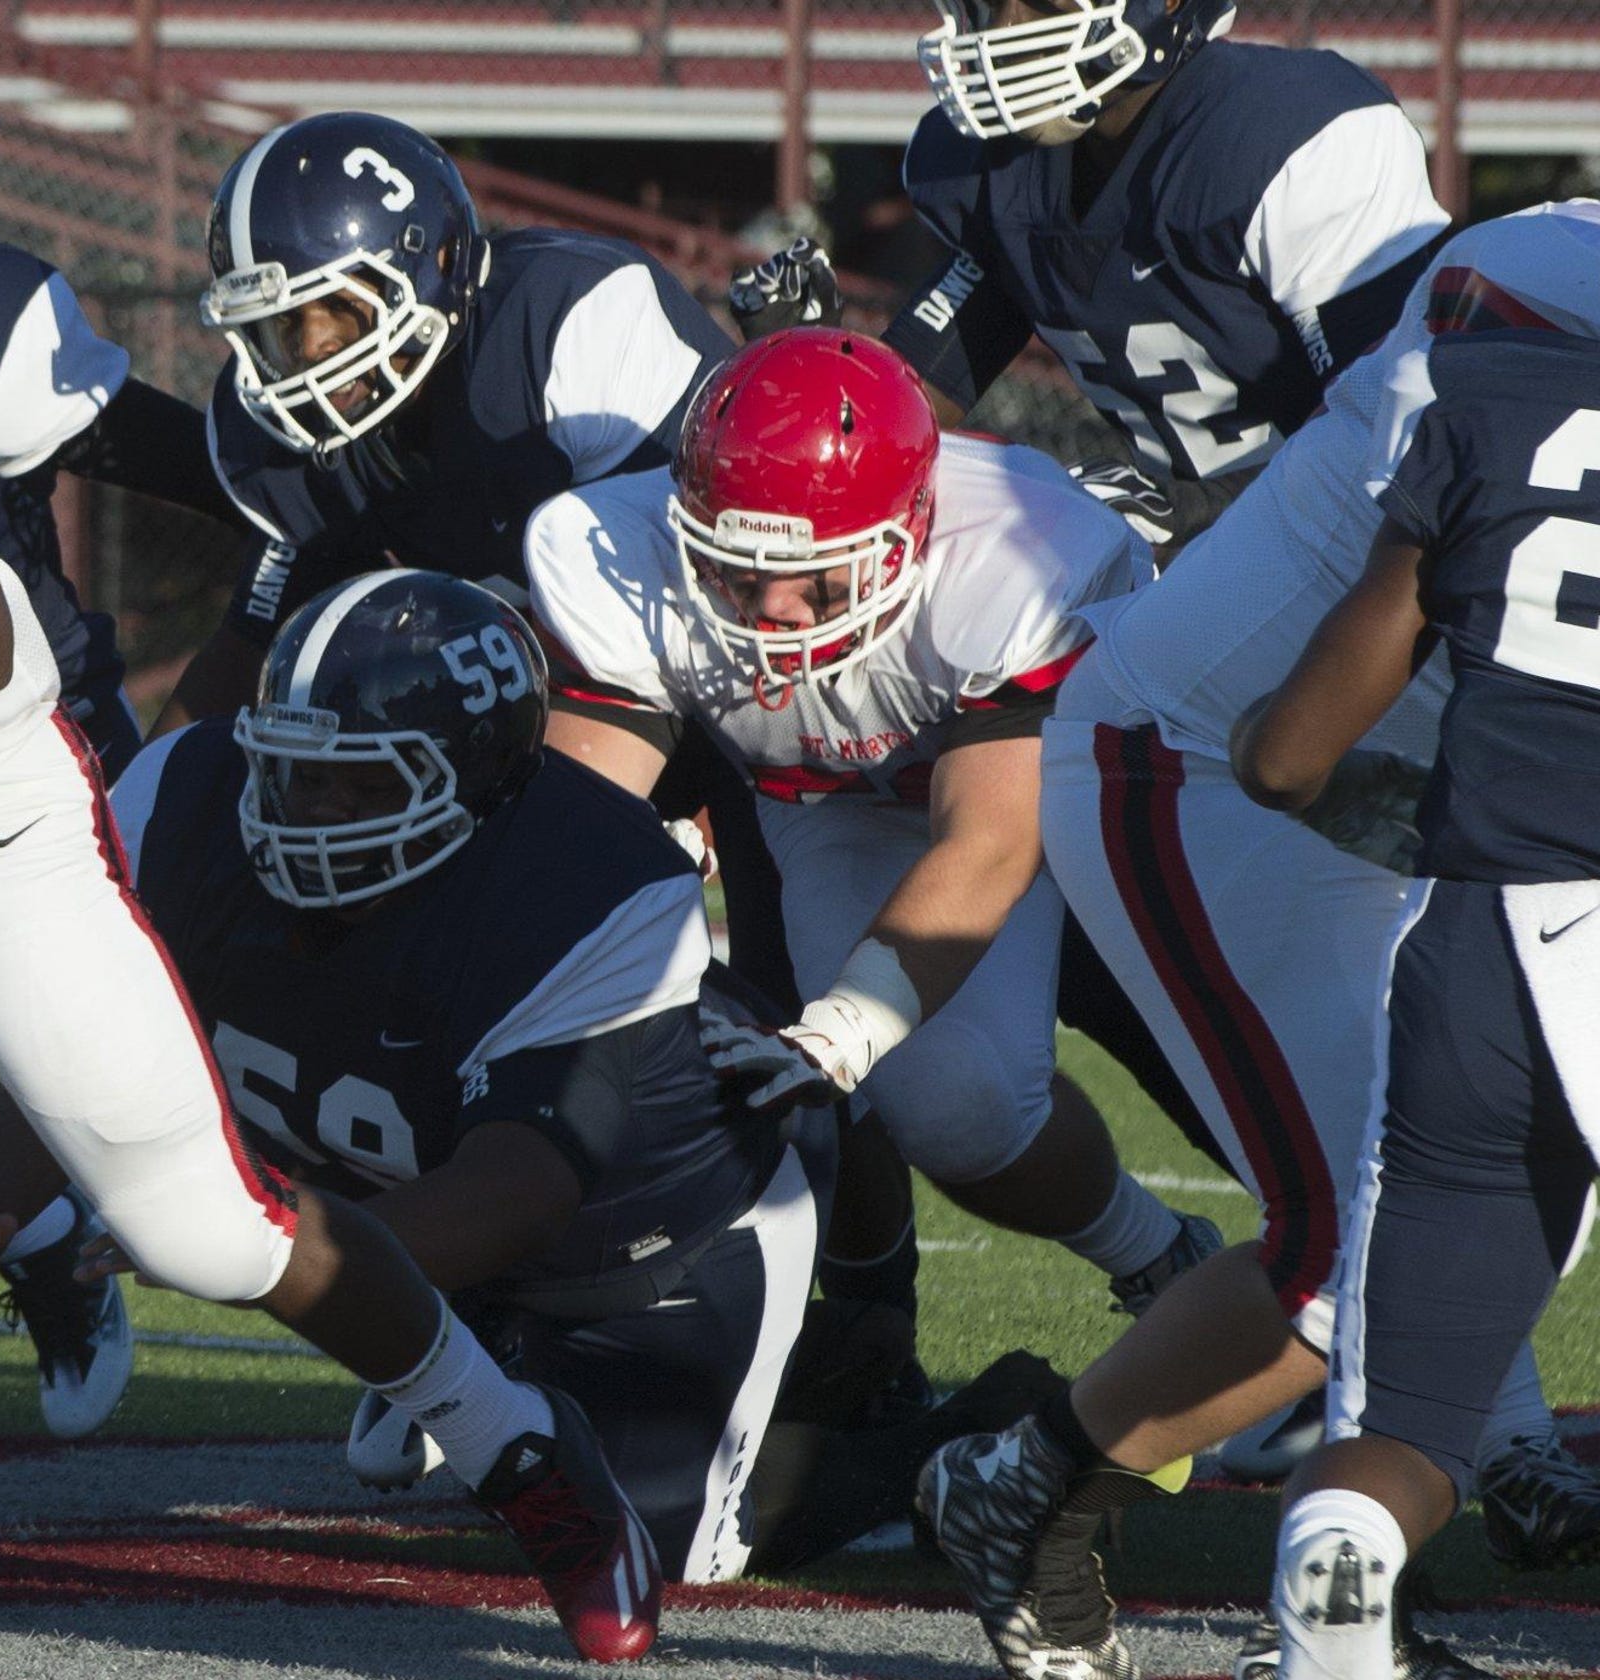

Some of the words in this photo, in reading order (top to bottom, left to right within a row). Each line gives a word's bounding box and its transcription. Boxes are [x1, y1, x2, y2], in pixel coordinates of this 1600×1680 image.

[342, 146, 416, 213] 3
[1035, 321, 1288, 479] 52
[739, 516, 791, 534] Riddell
[438, 623, 529, 715] 59
